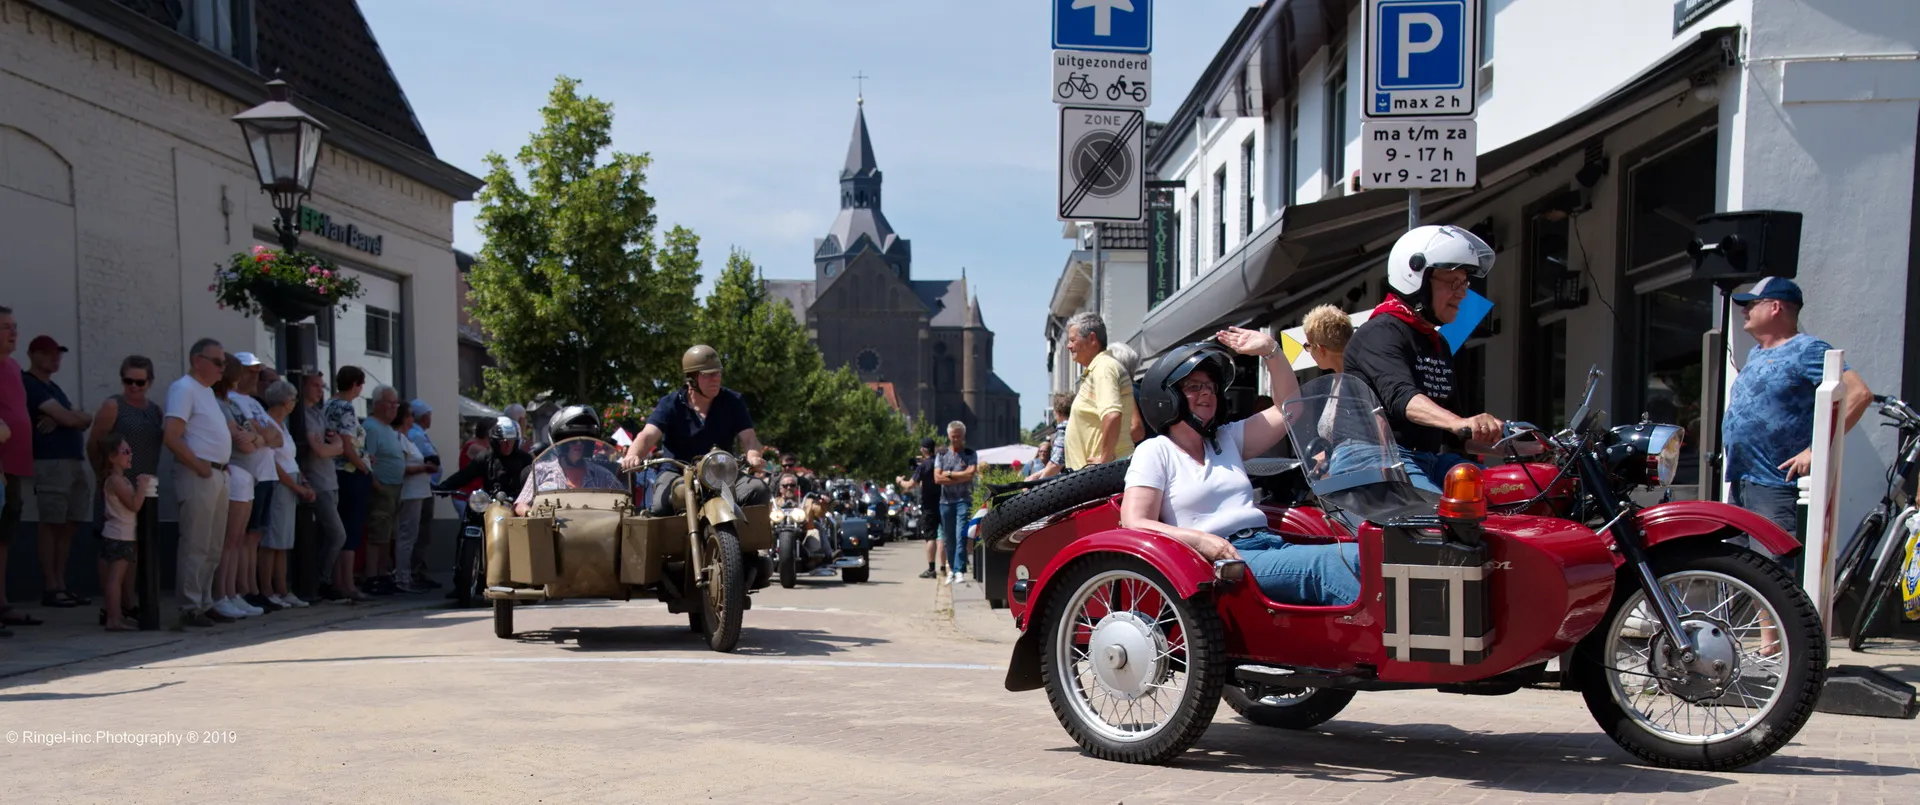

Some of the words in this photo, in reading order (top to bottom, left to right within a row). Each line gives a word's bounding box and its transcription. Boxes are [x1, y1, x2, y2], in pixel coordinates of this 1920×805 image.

[1397, 12, 1444, 78] P
[1058, 55, 1147, 70] uitgezonderd
[1394, 98, 1428, 109] max
[1435, 95, 1445, 108] 2
[1451, 95, 1460, 108] h
[1084, 115, 1121, 126] ZONE
[1373, 129, 1400, 141] ma
[1408, 125, 1439, 142] t/m
[1446, 128, 1467, 140] za
[1385, 148, 1397, 161] 9
[1418, 147, 1436, 161] 17
[1443, 147, 1453, 161] h
[1372, 170, 1392, 183] vr
[1398, 169, 1409, 182] 9
[1430, 168, 1448, 182] 21
[1456, 168, 1466, 182] h
